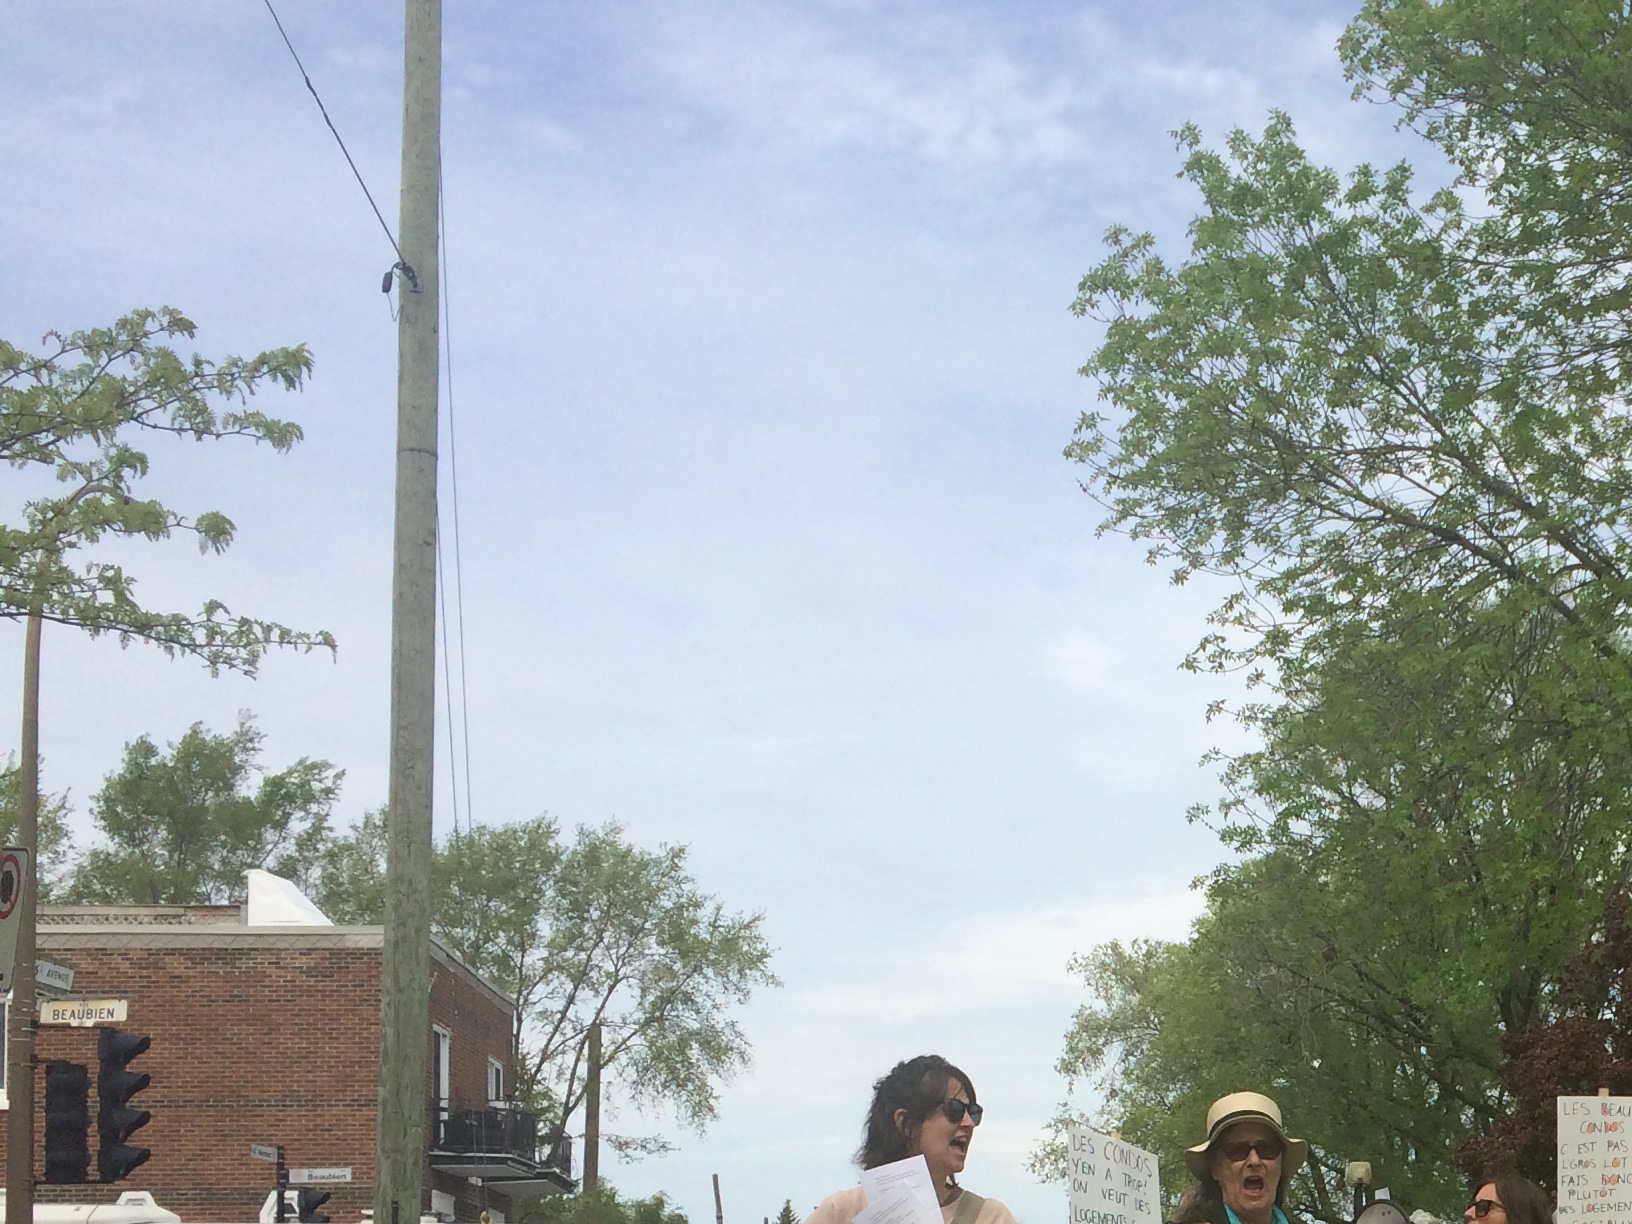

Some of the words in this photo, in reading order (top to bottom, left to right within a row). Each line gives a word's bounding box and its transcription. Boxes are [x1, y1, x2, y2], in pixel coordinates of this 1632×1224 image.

[53, 1008, 115, 1020] BEAUBIEN
[1563, 1102, 1591, 1116] LES
[1580, 1120, 1625, 1134] CONDOS
[1607, 1139, 1629, 1153] PAS
[1072, 1133, 1095, 1155] DES
[1104, 1141, 1153, 1178] CONDOS
[1603, 1157, 1629, 1169] LOT
[307, 1172, 347, 1181] Beaubien
[1105, 1168, 1113, 1182] A
[1561, 1174, 1589, 1187] FAIS
[1073, 1178, 1088, 1194] ON
[1101, 1188, 1128, 1207] VEUT
[1134, 1198, 1151, 1216] DES
